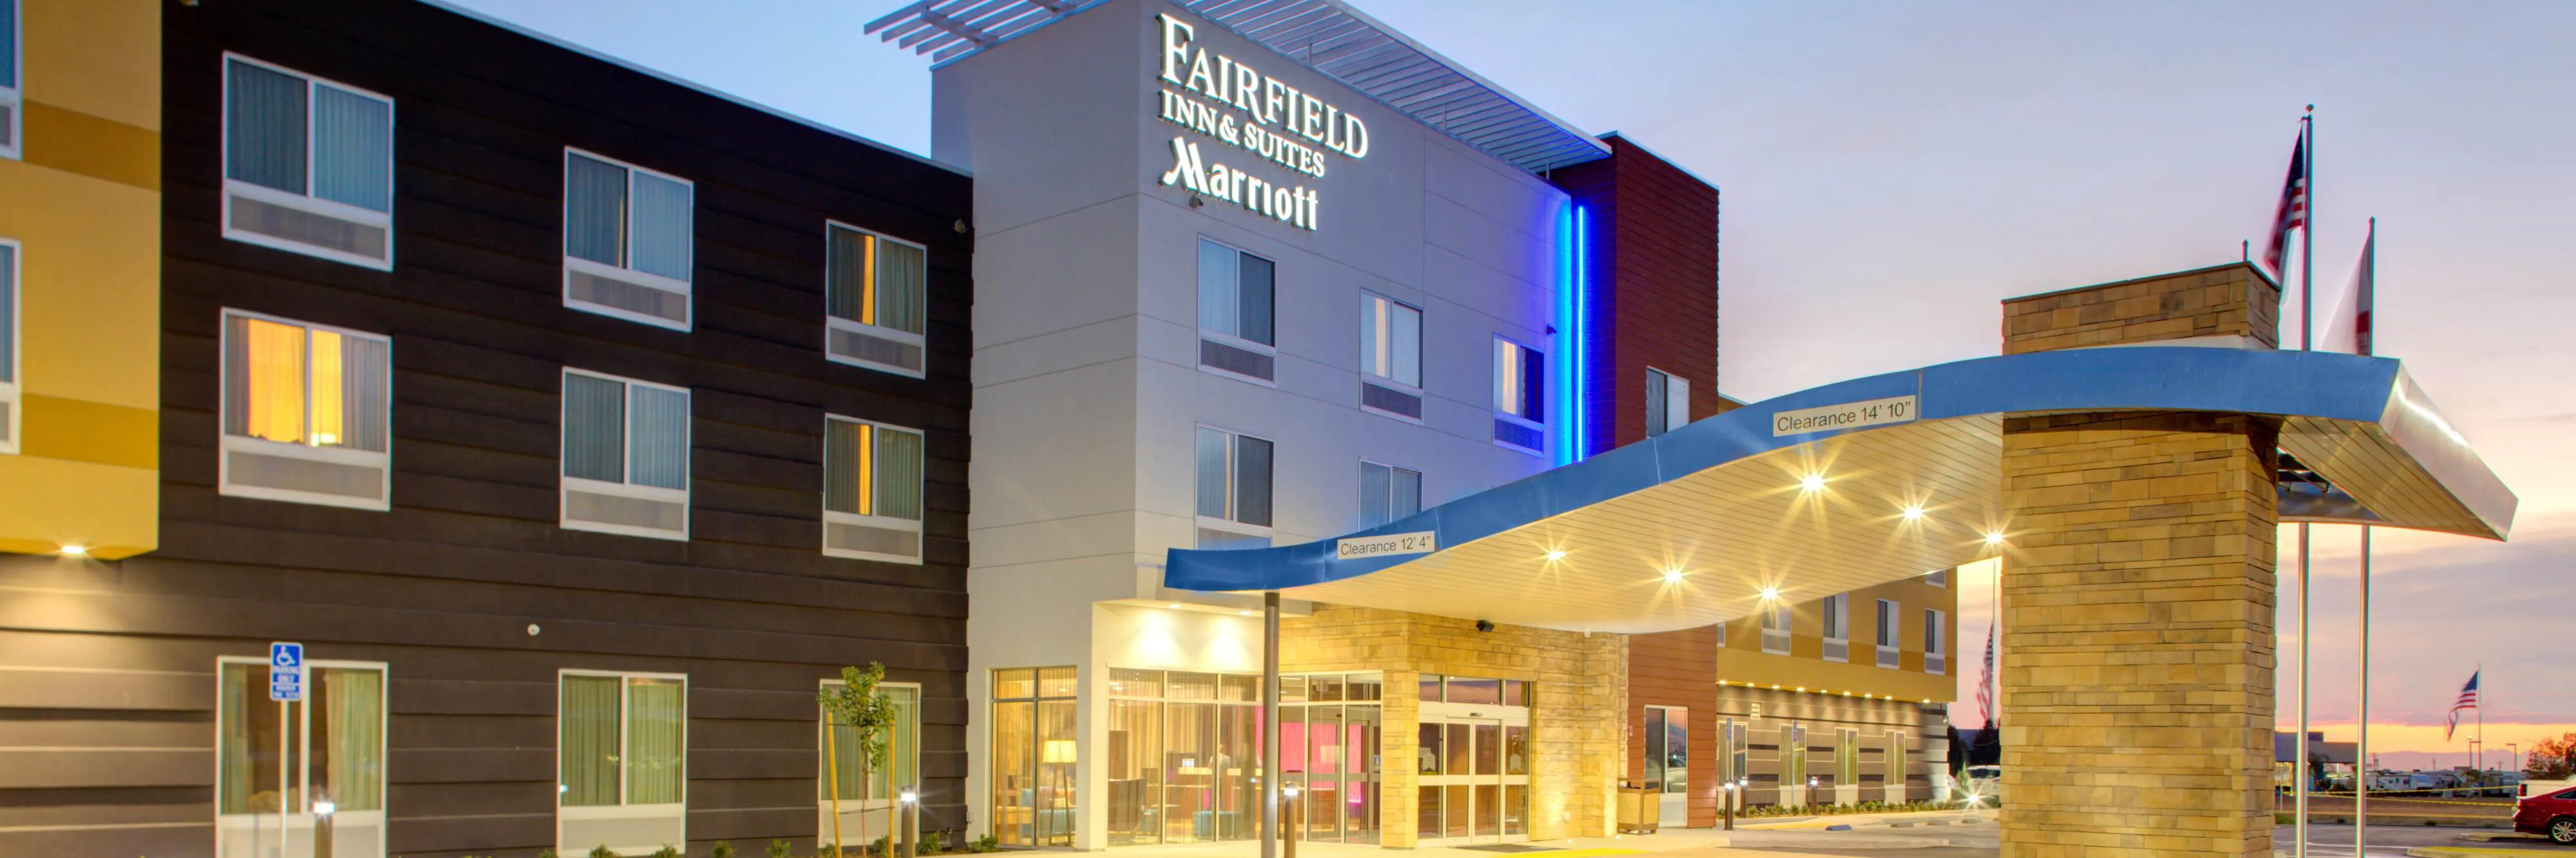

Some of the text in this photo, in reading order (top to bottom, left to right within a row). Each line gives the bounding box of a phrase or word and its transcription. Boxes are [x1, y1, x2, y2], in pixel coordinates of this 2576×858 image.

[1160, 12, 1368, 159] FAIRFIELD
[1244, 122, 1325, 178] SUITES
[1163, 136, 1318, 231] Marriott
[1777, 411, 1857, 431] Clearance
[1340, 541, 1396, 555] Clearance
